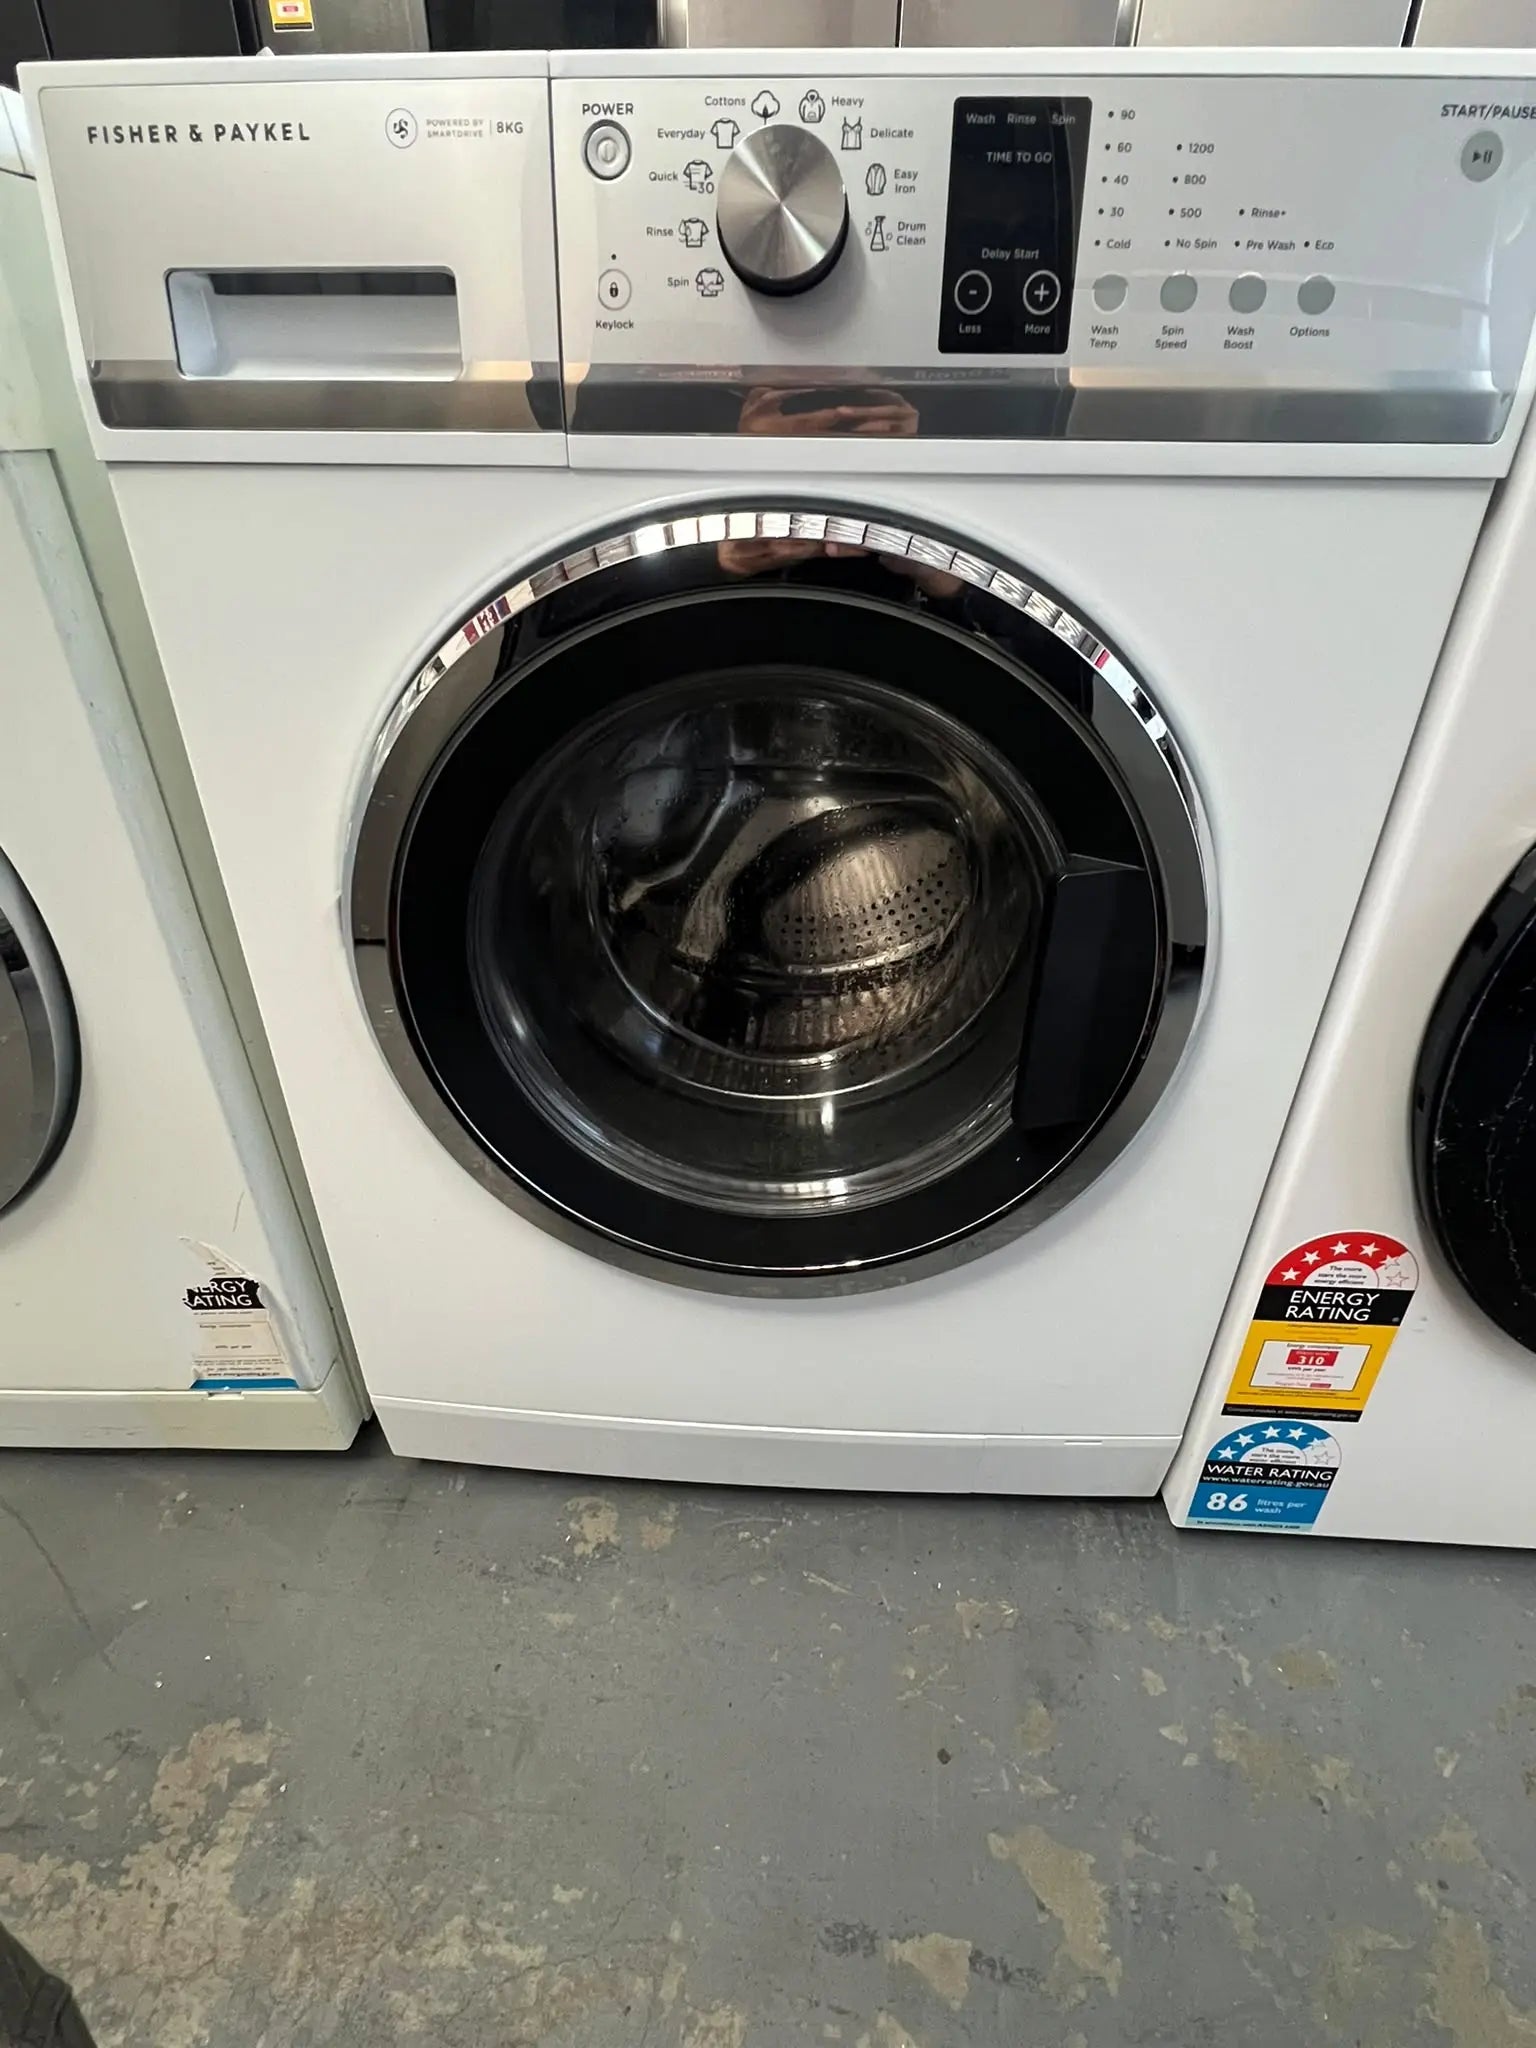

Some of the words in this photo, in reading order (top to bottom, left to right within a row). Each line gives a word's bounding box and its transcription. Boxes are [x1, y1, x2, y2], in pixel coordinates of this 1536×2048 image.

[704, 95, 746, 107] Cottons
[831, 95, 864, 109] Heavy
[582, 103, 634, 116] POWER
[1120, 109, 1136, 120] 90
[426, 118, 471, 127] POWERED
[472, 118, 484, 127] BY
[966, 112, 996, 125] Wash
[1007, 113, 1037, 125] Rinse
[1051, 112, 1076, 127] Spin
[87, 124, 178, 145] FISHER
[189, 123, 203, 143] &
[213, 122, 310, 142] PAYKEL
[427, 129, 484, 138] SMARTDRIVE
[496, 121, 524, 135] 8KG
[657, 127, 706, 140] Everyday
[870, 127, 915, 139] Delicate
[1117, 142, 1132, 153] 60
[1188, 142, 1215, 154] 1200
[986, 151, 1012, 163] TIME
[1016, 151, 1031, 163] TO
[1034, 151, 1053, 164] GO
[649, 171, 679, 182] Quick
[894, 168, 919, 181] Easy
[1113, 174, 1129, 185] 40
[1184, 174, 1207, 185] 800
[697, 181, 715, 194] 30
[895, 183, 916, 194] Iron
[1109, 207, 1125, 218] 30
[1180, 207, 1202, 218] 500
[646, 226, 674, 237] Rinse
[897, 221, 926, 232] Drum
[897, 235, 926, 246] Clean
[1106, 238, 1131, 250] Cold
[1176, 238, 1191, 249] No
[1194, 238, 1218, 250] Spin
[1246, 239, 1264, 250] Pre
[1267, 240, 1296, 251] Wash
[1314, 240, 1335, 250] Eco
[981, 248, 1011, 261] Delay
[1014, 248, 1040, 260] Start
[667, 276, 690, 288] Spin
[595, 319, 635, 331] Keylock
[959, 323, 982, 334] Less
[1024, 323, 1051, 334] More
[1091, 325, 1119, 335] Wash
[1161, 325, 1185, 336] Spin
[1226, 326, 1255, 336] Wash
[1289, 326, 1331, 338] Options
[1090, 339, 1118, 350] Temp
[1154, 339, 1188, 350] Speed
[1223, 340, 1254, 350] Boost
[1290, 1289, 1380, 1306] ENERGY
[1285, 1305, 1372, 1322] RATING
[1297, 1355, 1325, 1366] 310
[1207, 1463, 1263, 1477] WATER
[1268, 1467, 1333, 1481] RATING
[1202, 1475, 1330, 1488] www.waterrating.gov.au
[1206, 1492, 1249, 1512] 86
[1257, 1498, 1284, 1507] litres
[1286, 1501, 1306, 1509] per
